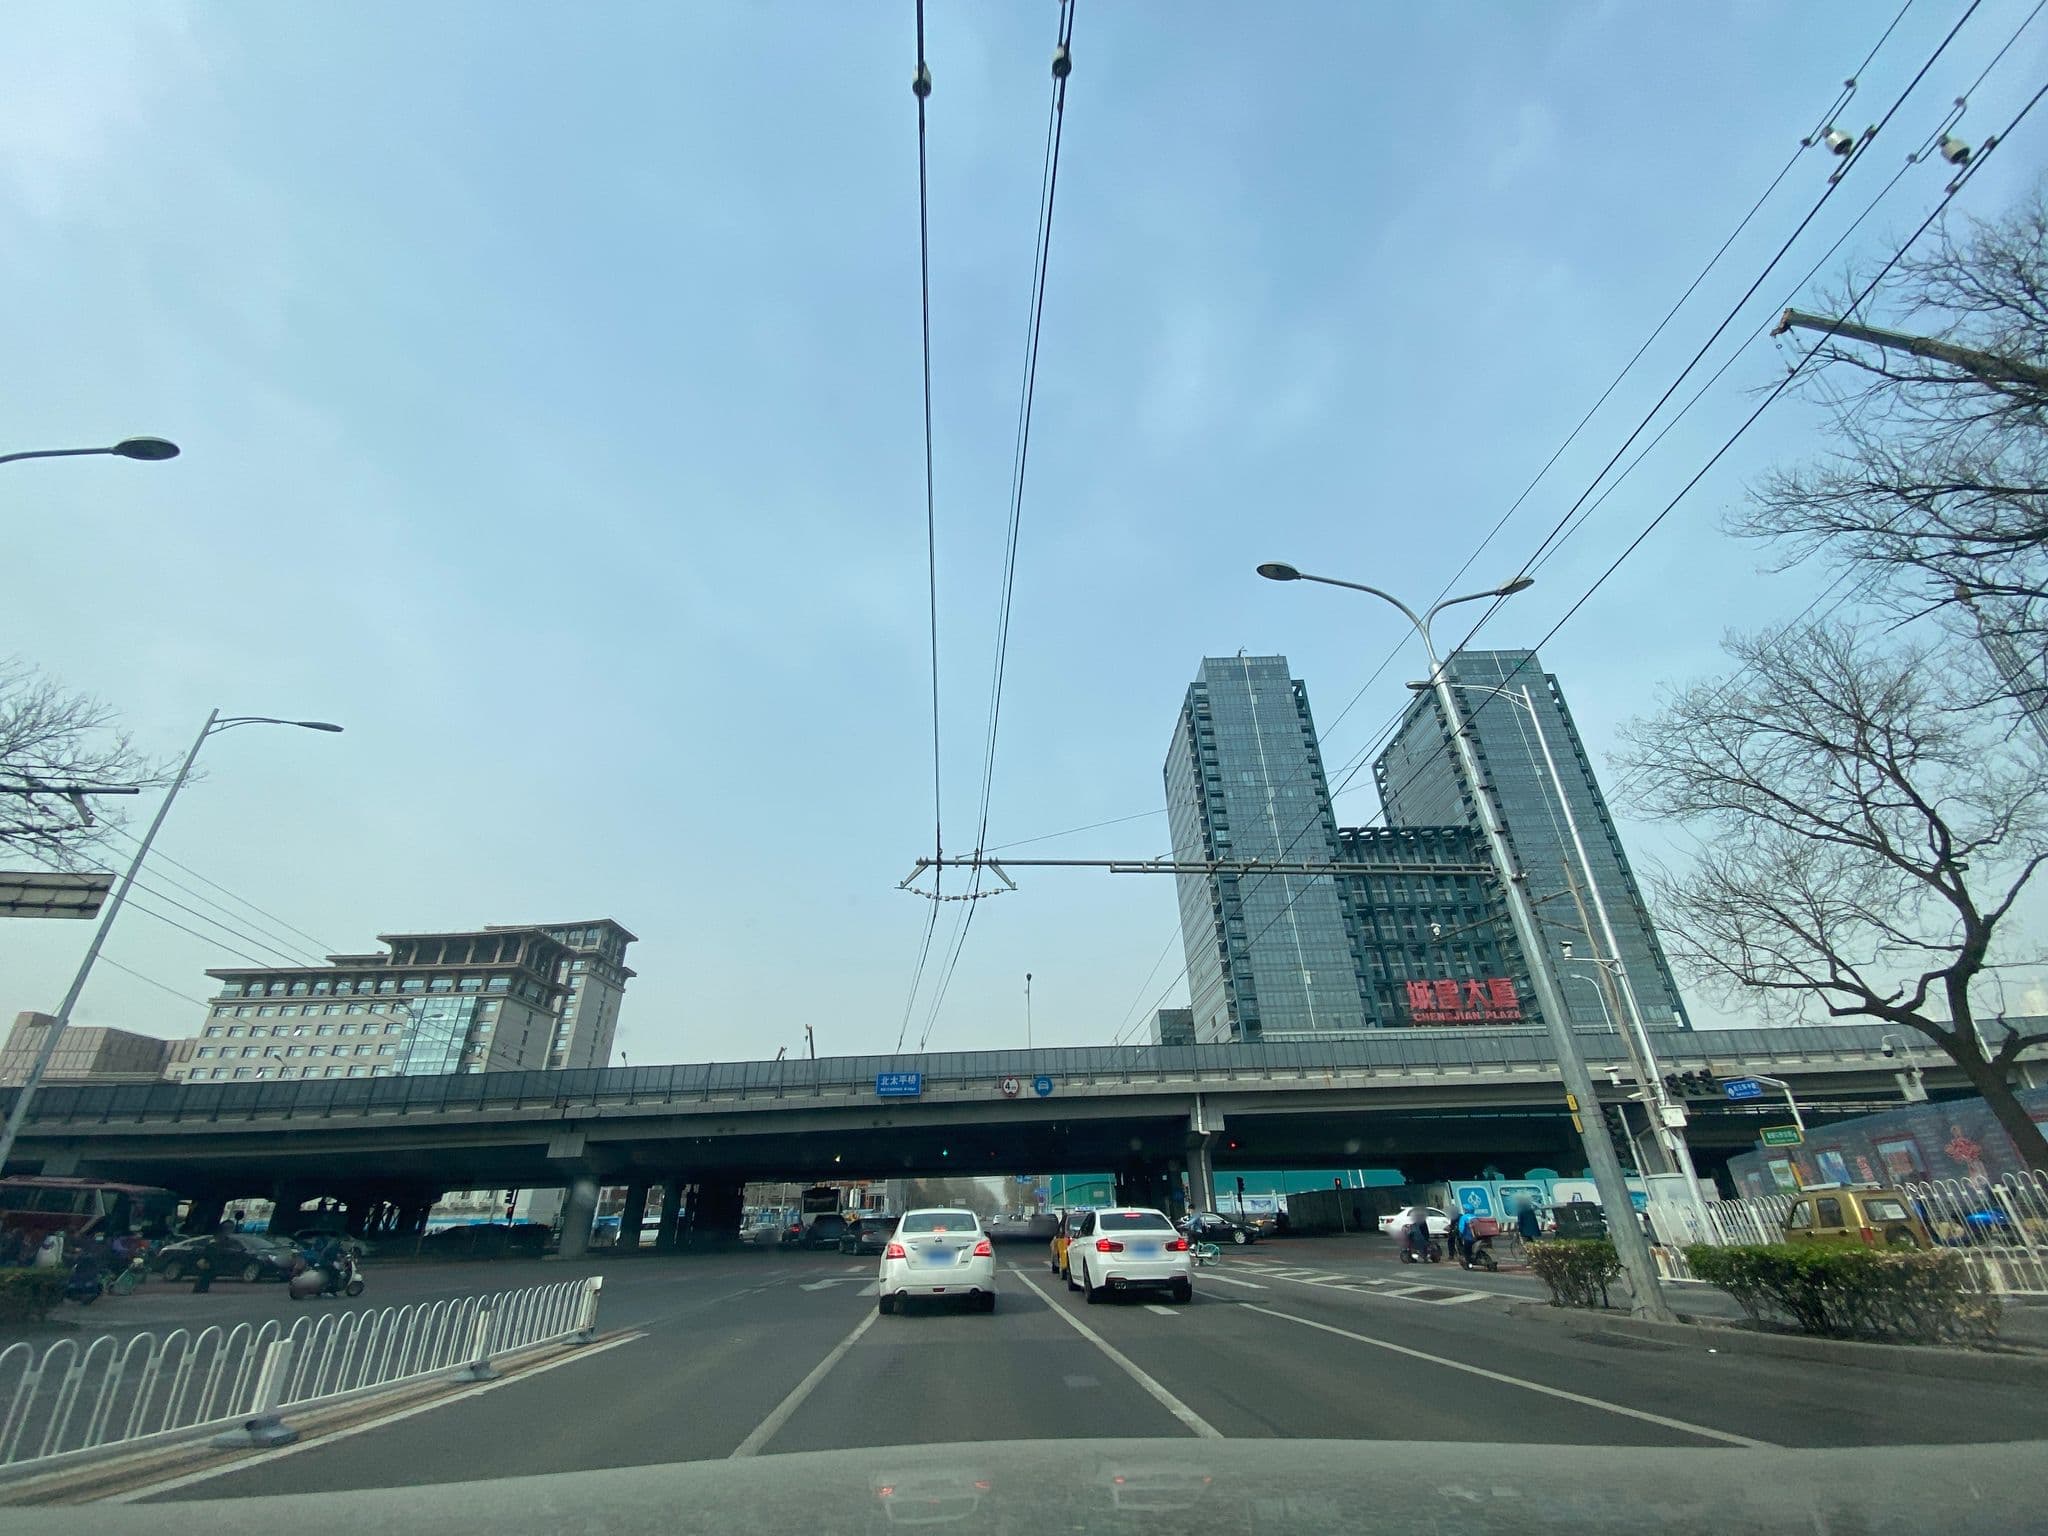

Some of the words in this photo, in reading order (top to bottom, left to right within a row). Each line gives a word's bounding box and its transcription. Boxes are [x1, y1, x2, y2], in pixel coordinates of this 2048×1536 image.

[1485, 1010, 1521, 1020] PLAZA
[880, 1075, 917, 1086] 北太平桥
